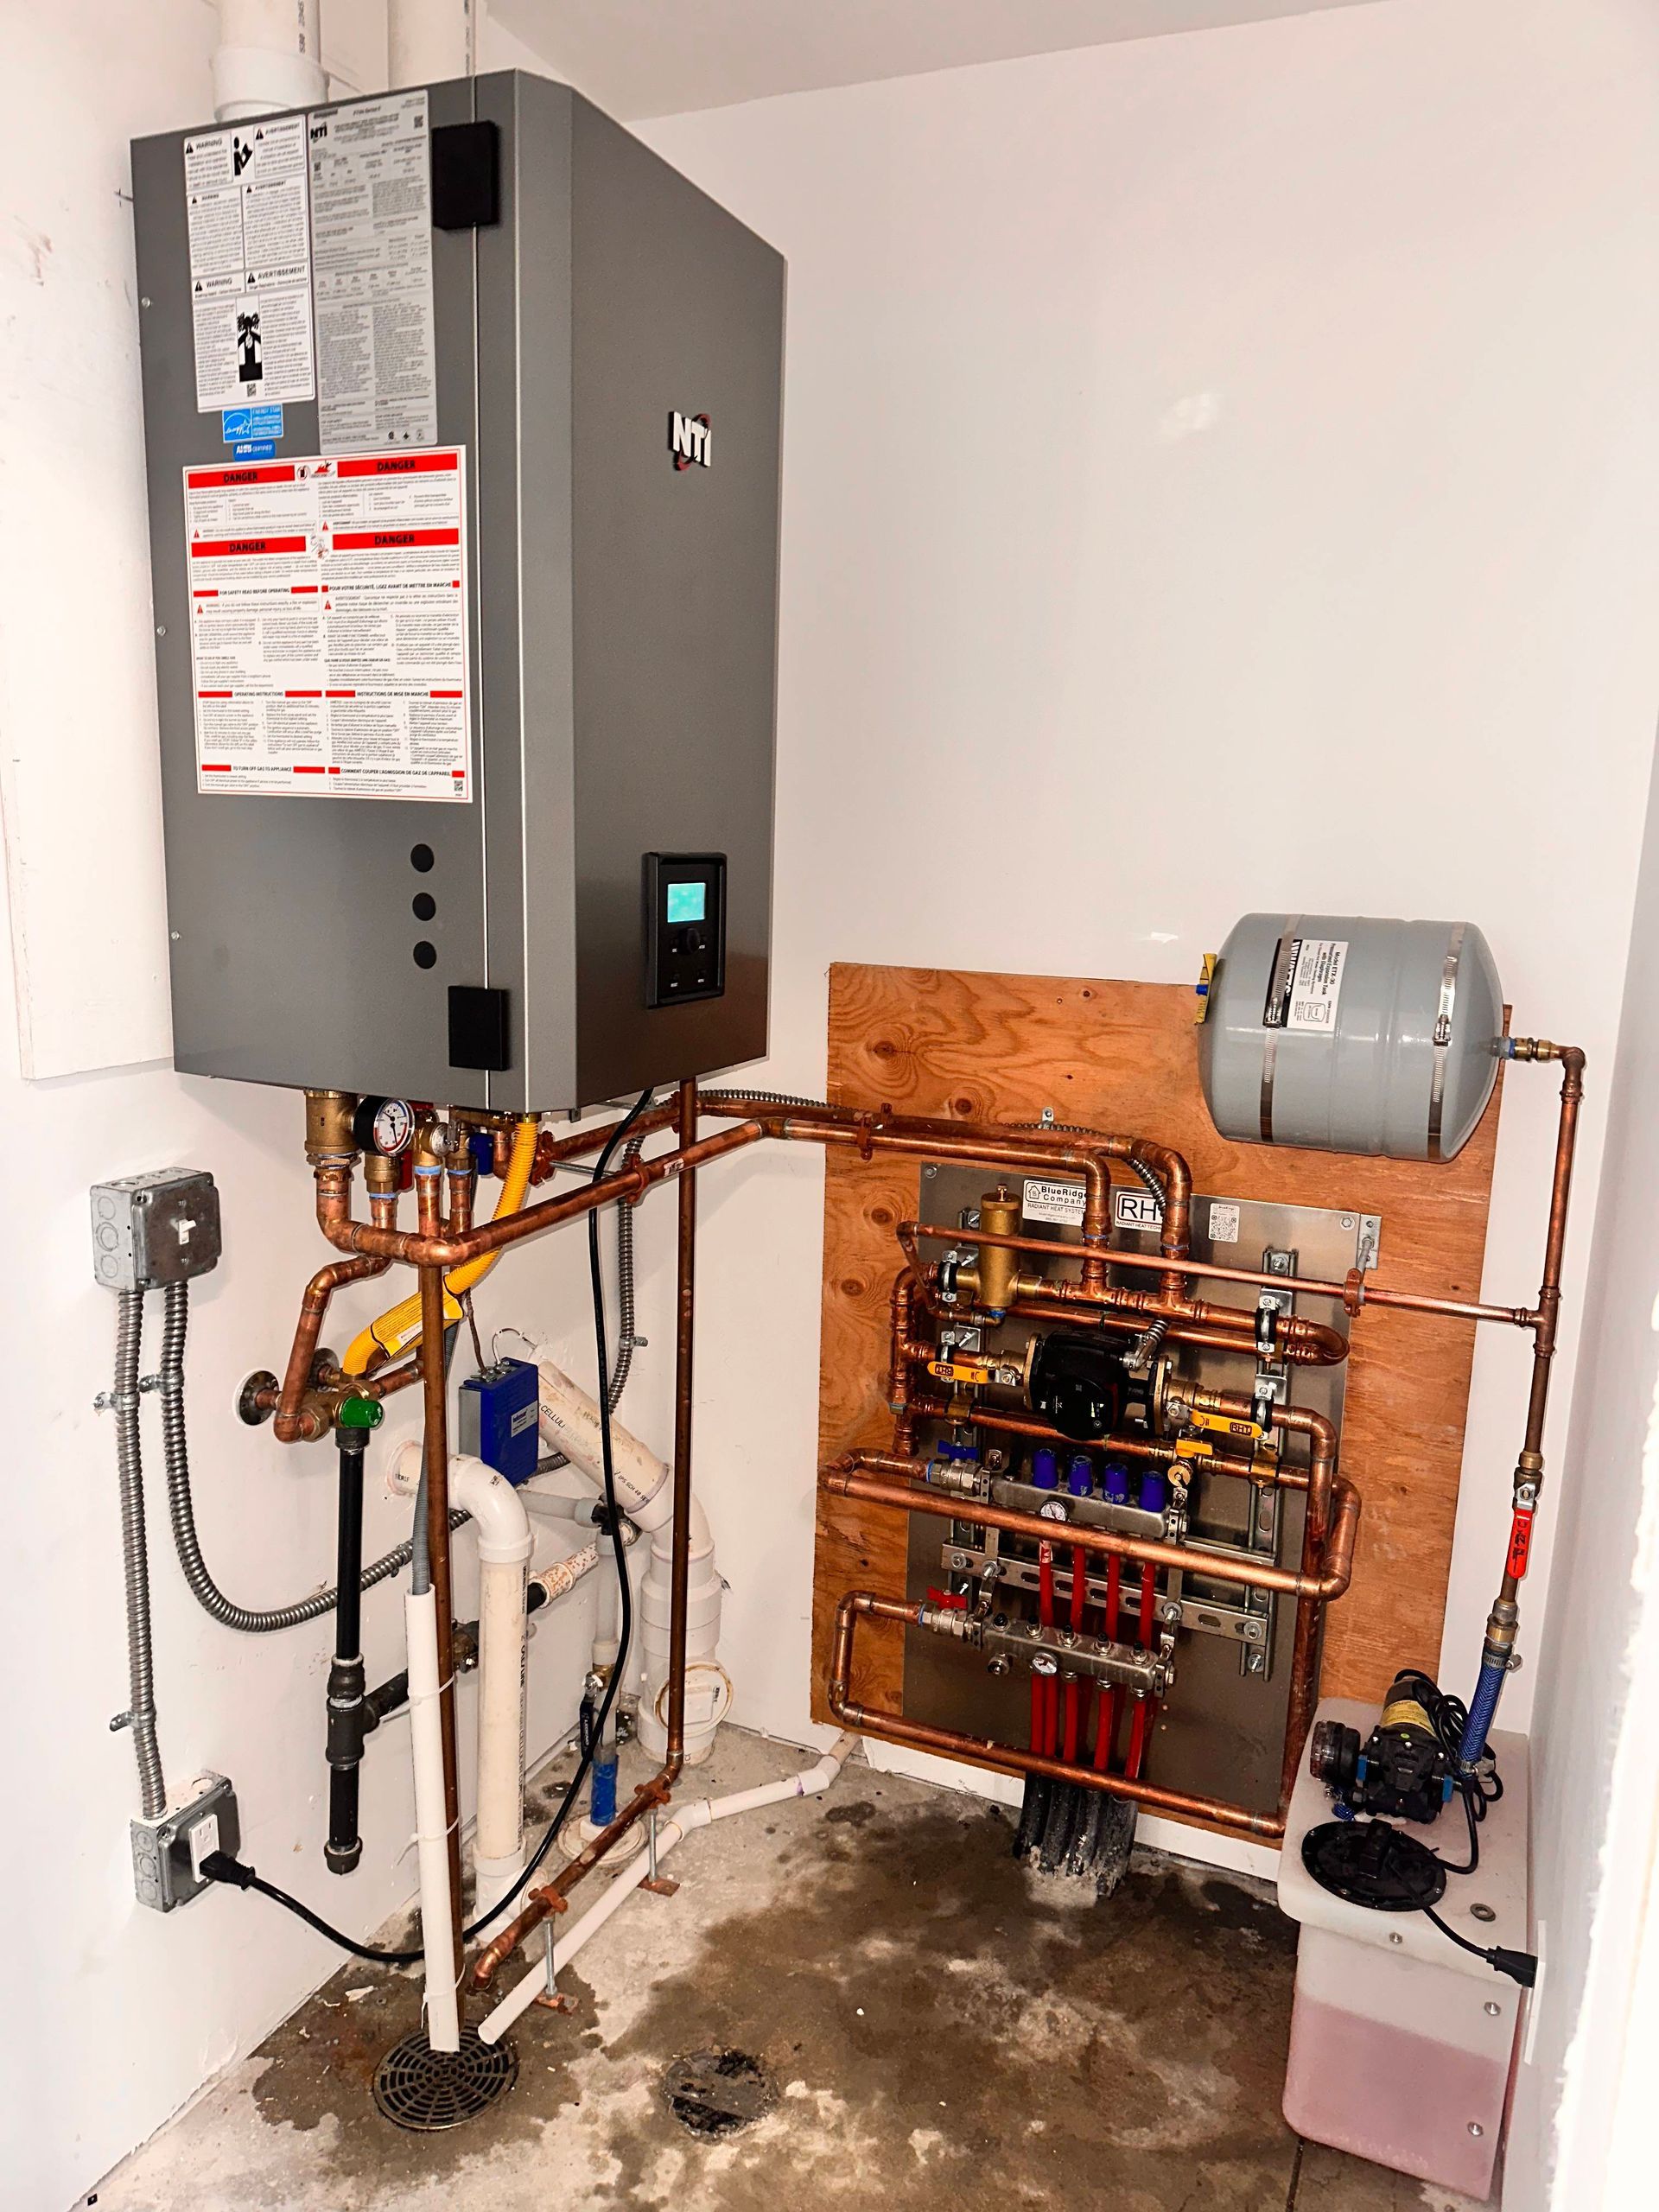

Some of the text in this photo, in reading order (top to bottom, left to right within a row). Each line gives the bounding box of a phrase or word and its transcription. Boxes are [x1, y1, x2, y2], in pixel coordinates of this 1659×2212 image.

[673, 411, 711, 467] NTI
[377, 460, 416, 472] DANGER
[223, 472, 257, 483] DANGER
[374, 534, 415, 545] DANGER
[229, 542, 266, 553] DANGER
